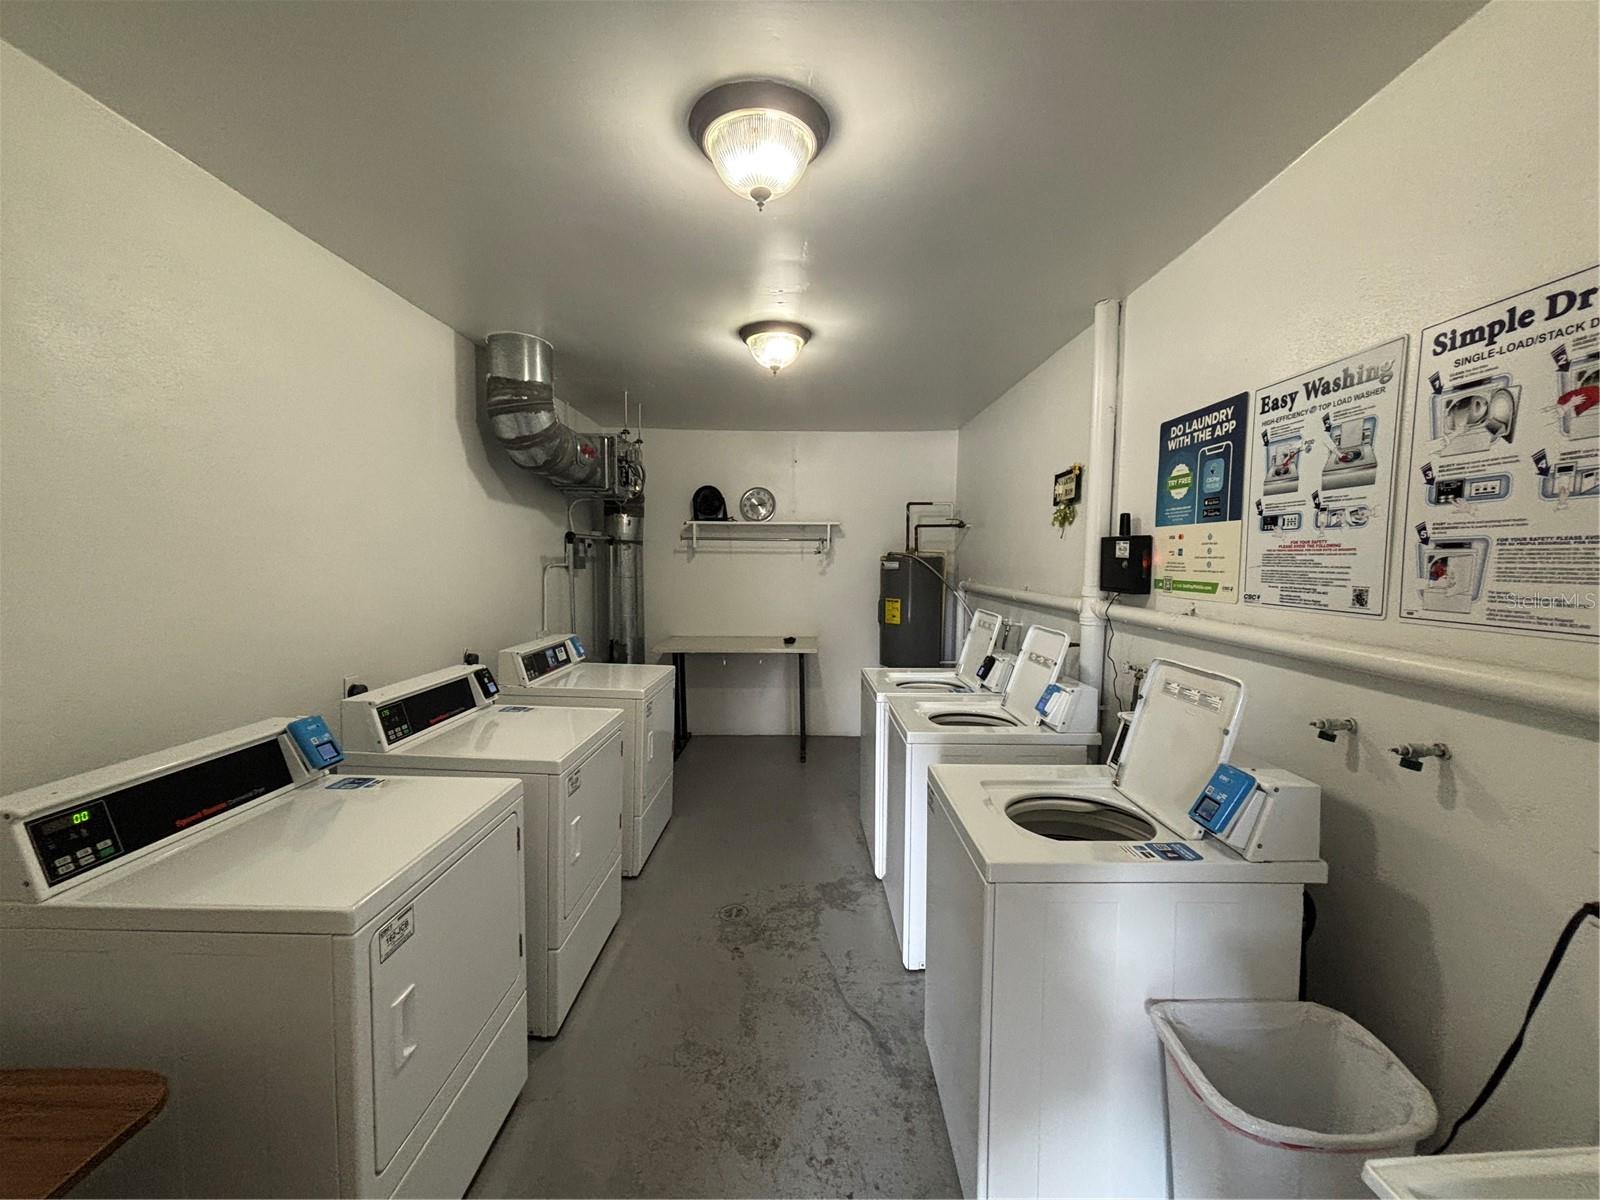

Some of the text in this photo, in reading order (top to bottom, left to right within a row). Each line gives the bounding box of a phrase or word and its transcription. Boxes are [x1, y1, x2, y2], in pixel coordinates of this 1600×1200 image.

[1432, 306, 1535, 356] Simple
[1544, 287, 1599, 321] Dr
[1454, 321, 1586, 368] SINGLE-LOAD/STACK
[1558, 354, 1567, 366] 2
[1259, 391, 1299, 415] Easy
[1303, 359, 1396, 401] Washing
[1170, 405, 1235, 438] DO LAUNDRY
[1261, 409, 1309, 427] HIGH-EFFICIENCY
[1318, 402, 1332, 412] TOP
[1333, 396, 1353, 407] LOAD
[1353, 386, 1386, 401] WASHER
[1167, 419, 1237, 451] WITH THE APP
[1425, 471, 1432, 479] 3
[1538, 460, 1546, 469] 4
[1178, 477, 1192, 485] FREE
[1420, 530, 1427, 538] 5
